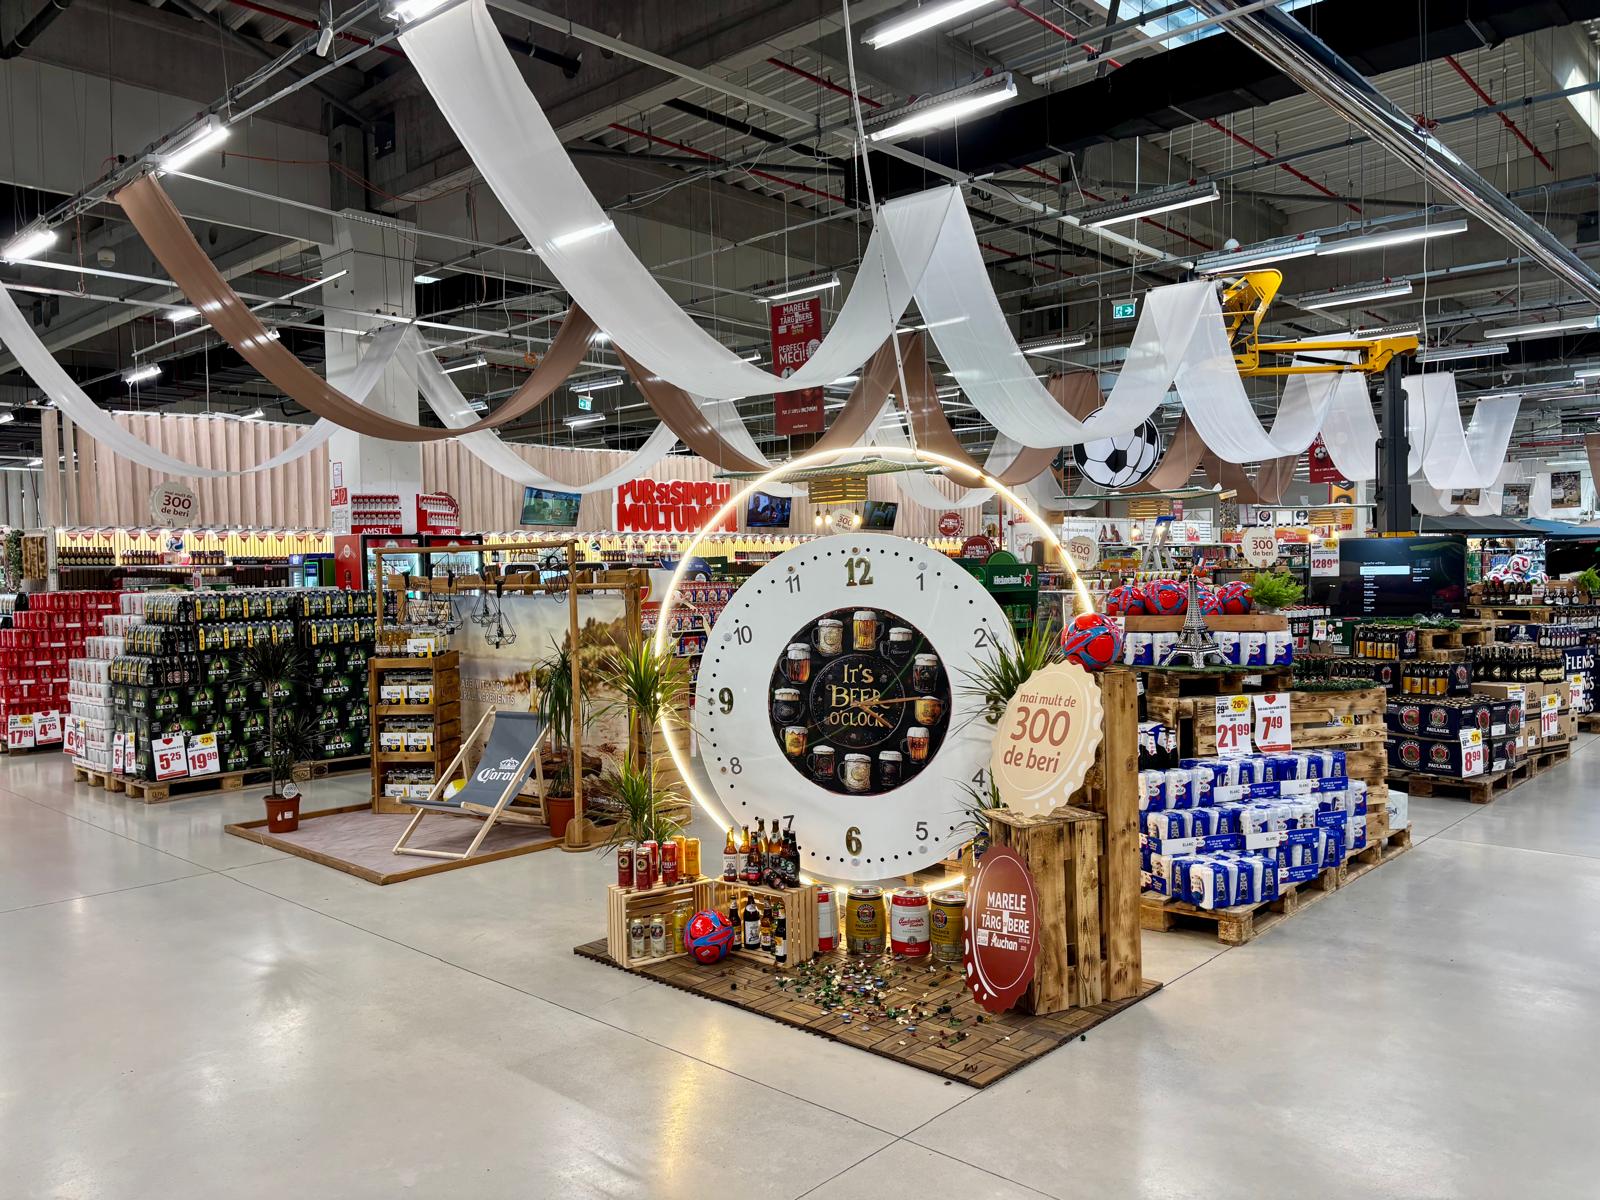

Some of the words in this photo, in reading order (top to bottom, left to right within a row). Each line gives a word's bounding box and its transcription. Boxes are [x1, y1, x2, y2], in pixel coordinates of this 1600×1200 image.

[783, 301, 810, 314] MARELE
[778, 342, 806, 353] PERFECT
[780, 344, 806, 365] MECI!
[617, 478, 656, 504] PUR
[162, 494, 192, 510] 300
[173, 509, 190, 517] beri
[1071, 544, 1090, 555] 300
[1252, 540, 1274, 550] 300
[844, 558, 874, 586] 12
[993, 576, 1022, 584] Heineken
[785, 574, 800, 594] 11
[916, 572, 924, 592] 1
[734, 626, 752, 645] 10
[974, 628, 988, 648] 2
[461, 680, 472, 688] ADE
[718, 688, 734, 714] 9
[986, 694, 1001, 724] 3
[826, 683, 890, 709] BEER
[1020, 692, 1038, 704] mai
[1039, 694, 1062, 706] mult
[1064, 696, 1076, 708] de
[830, 710, 884, 728] O'CLOCK
[1010, 706, 1070, 746] 300
[1004, 745, 1024, 767] de
[1026, 748, 1060, 773] beri
[477, 766, 525, 783] Coron
[730, 756, 742, 774] 8
[972, 768, 986, 787] 4
[782, 814, 794, 830] 7
[846, 826, 862, 856] 6
[916, 822, 928, 840] 5
[986, 891, 1027, 912] MARELE
[981, 911, 1002, 930] TÂRG
[1008, 918, 1030, 934] BERE
[990, 932, 1018, 951] Auchan
